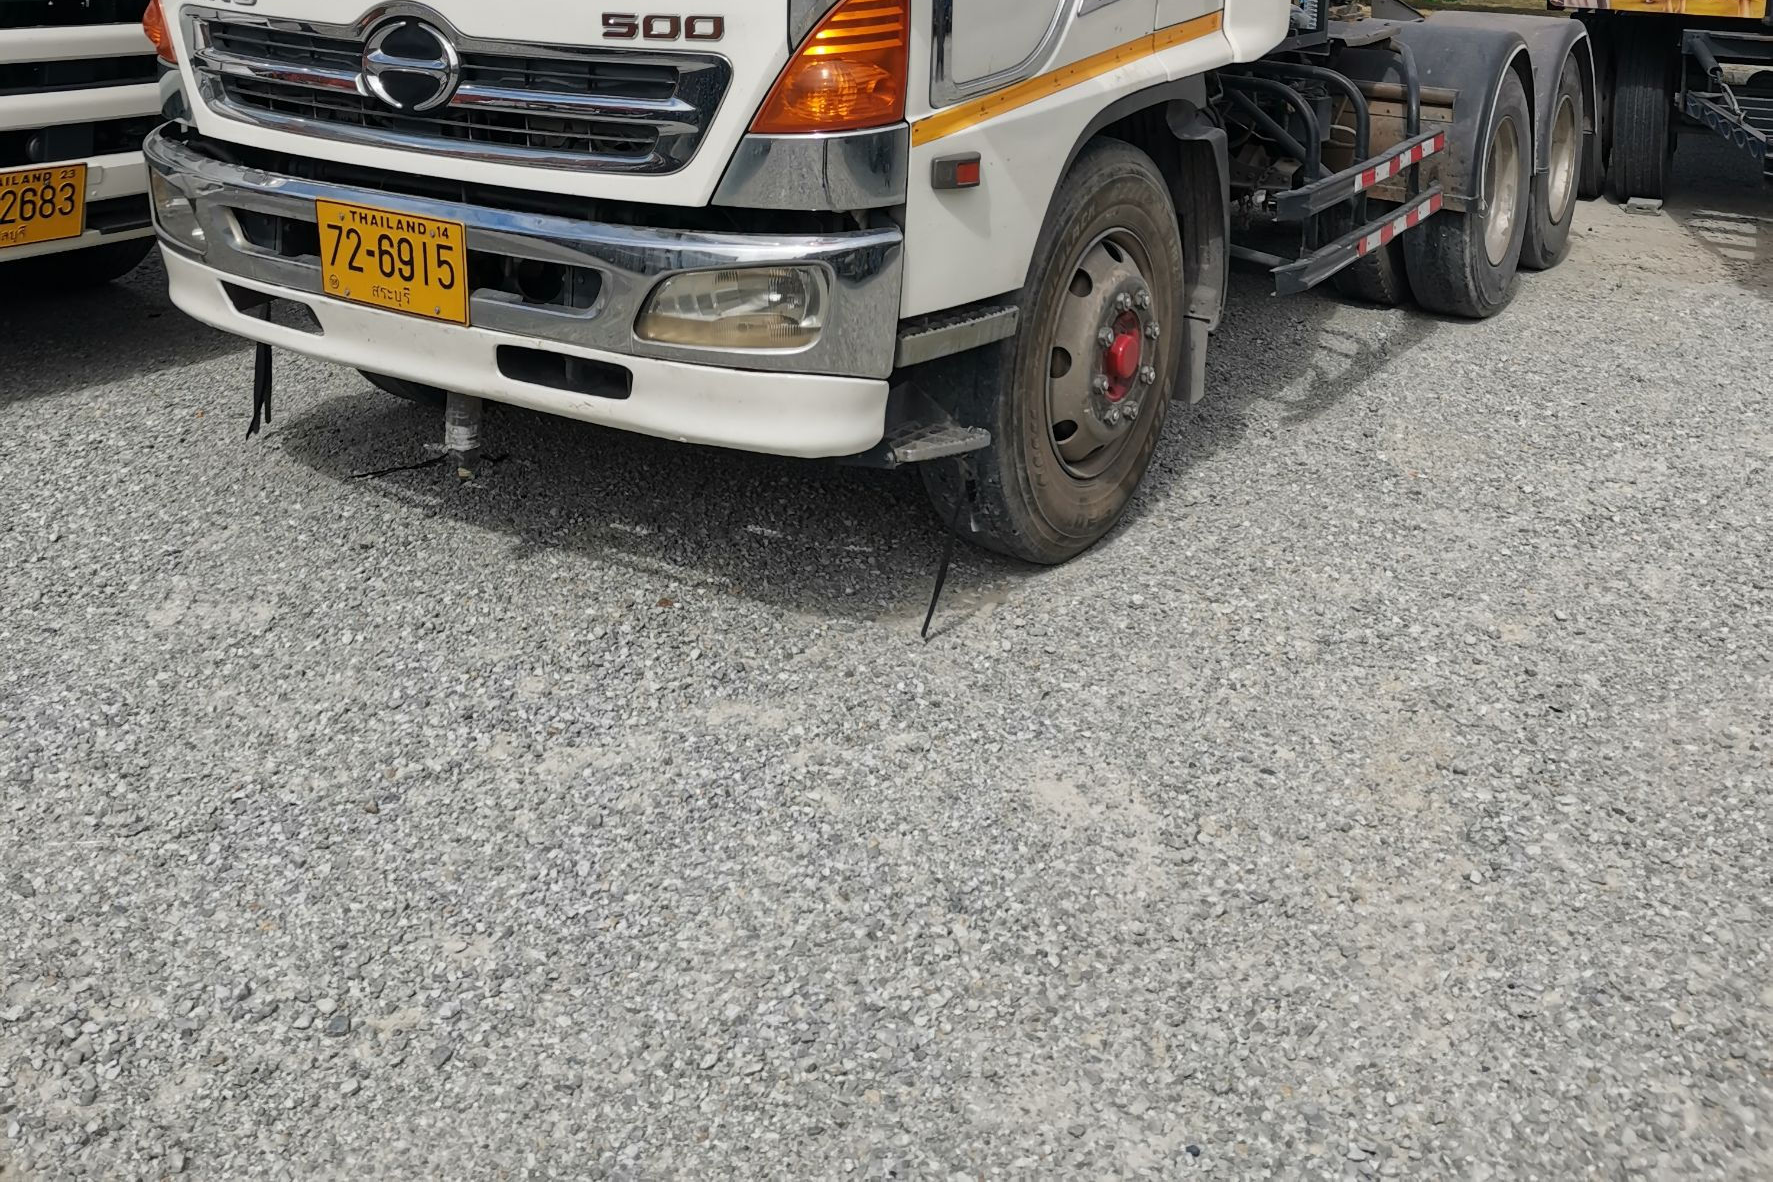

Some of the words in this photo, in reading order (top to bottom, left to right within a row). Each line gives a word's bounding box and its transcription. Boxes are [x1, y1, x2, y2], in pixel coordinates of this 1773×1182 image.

[601, 12, 725, 42] 500
[0, 171, 52, 187] ILAND
[60, 169, 76, 179] 23
[349, 210, 427, 235] THAILAND
[436, 226, 449, 240] 14
[327, 223, 455, 290] 72-6915
[372, 285, 410, 307] สระบุรี
